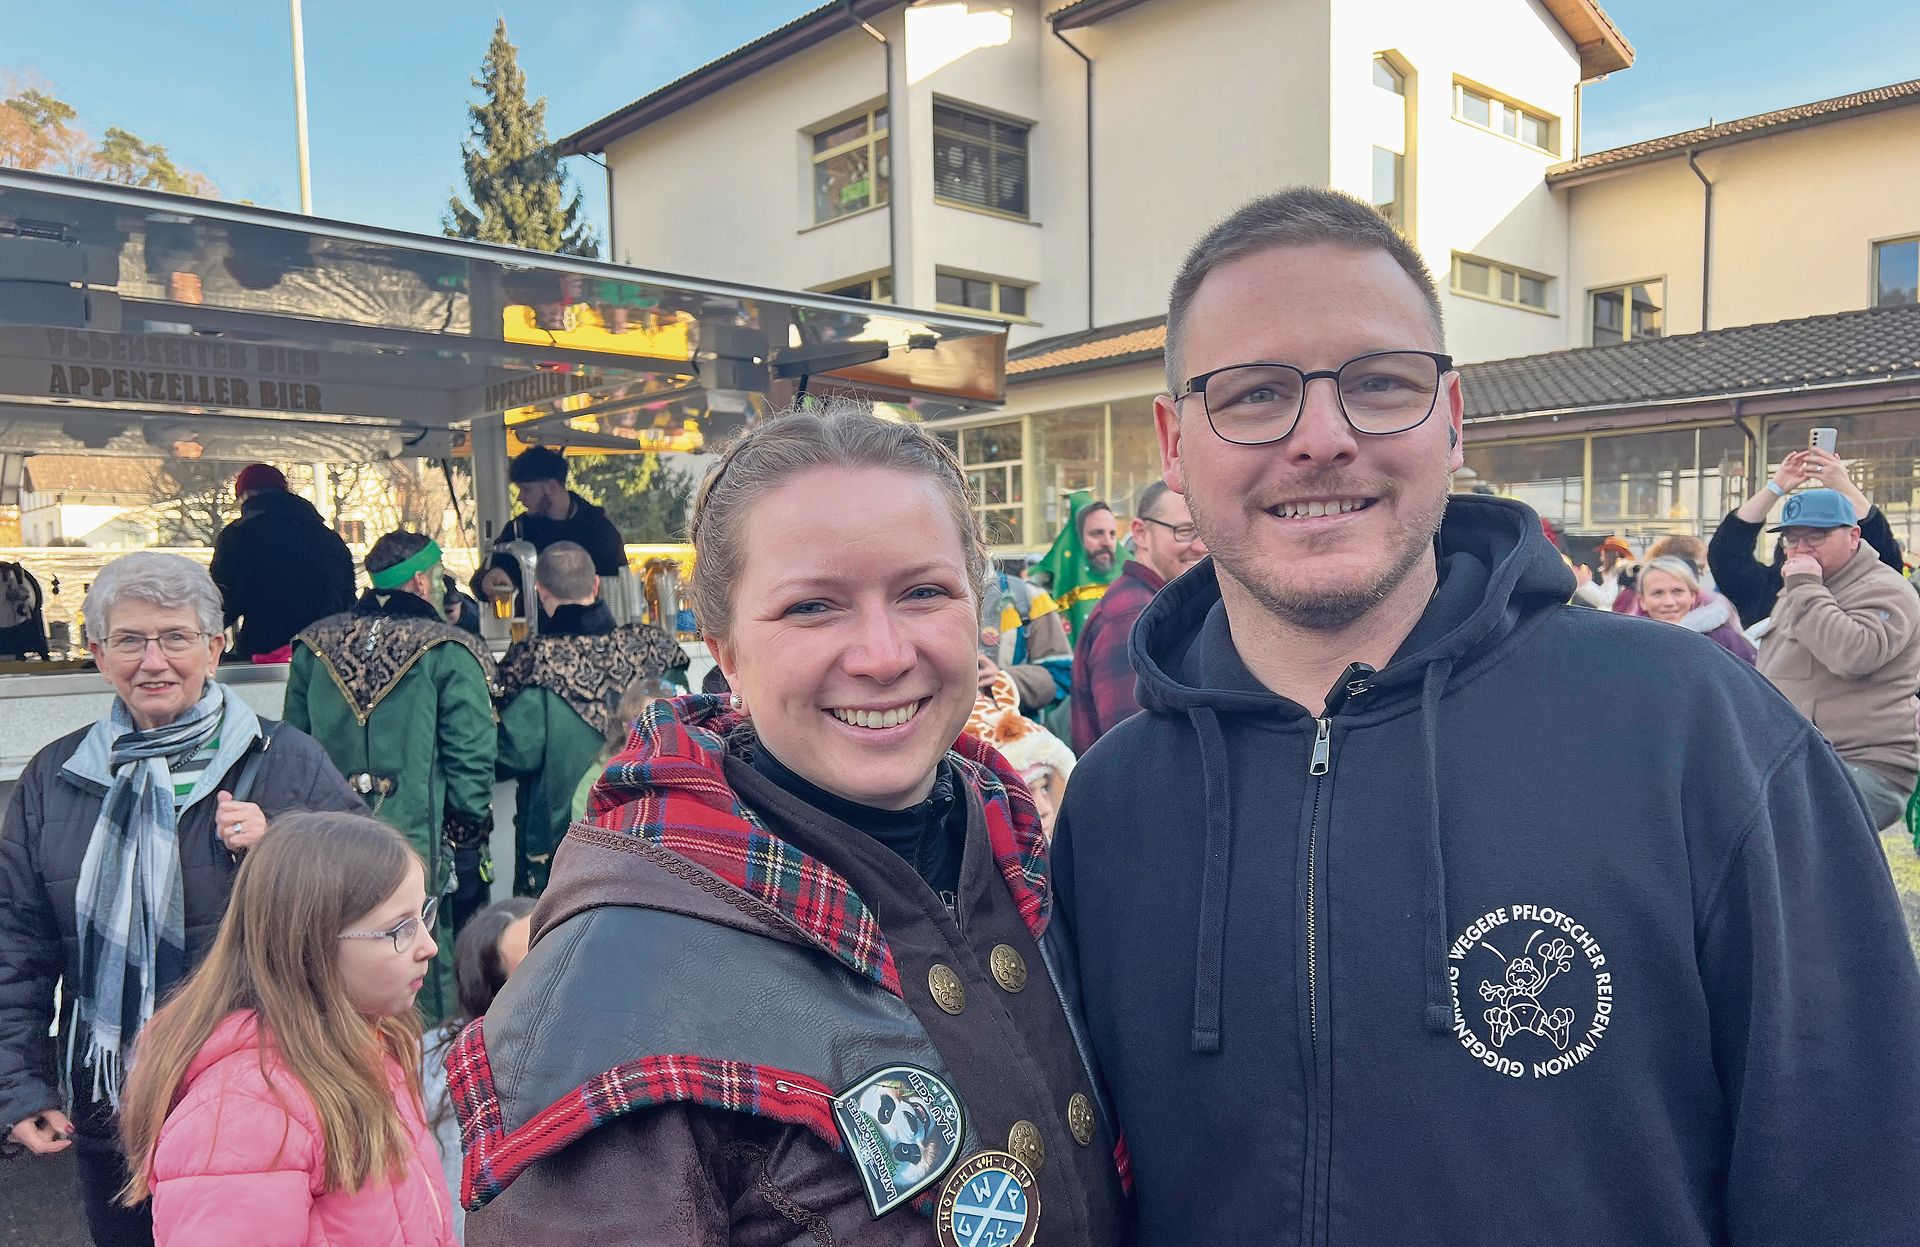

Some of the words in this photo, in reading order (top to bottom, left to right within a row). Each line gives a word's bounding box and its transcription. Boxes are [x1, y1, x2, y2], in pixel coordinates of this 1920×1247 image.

[49, 364, 250, 406] APPENZELLER
[259, 380, 322, 409] BIER
[1448, 907, 1509, 960] WEGERE
[1512, 904, 1606, 970] PFLOTSCHER
[930, 1106, 957, 1145] FLAU
[971, 1175, 992, 1203] W
[1006, 1188, 1020, 1210] P
